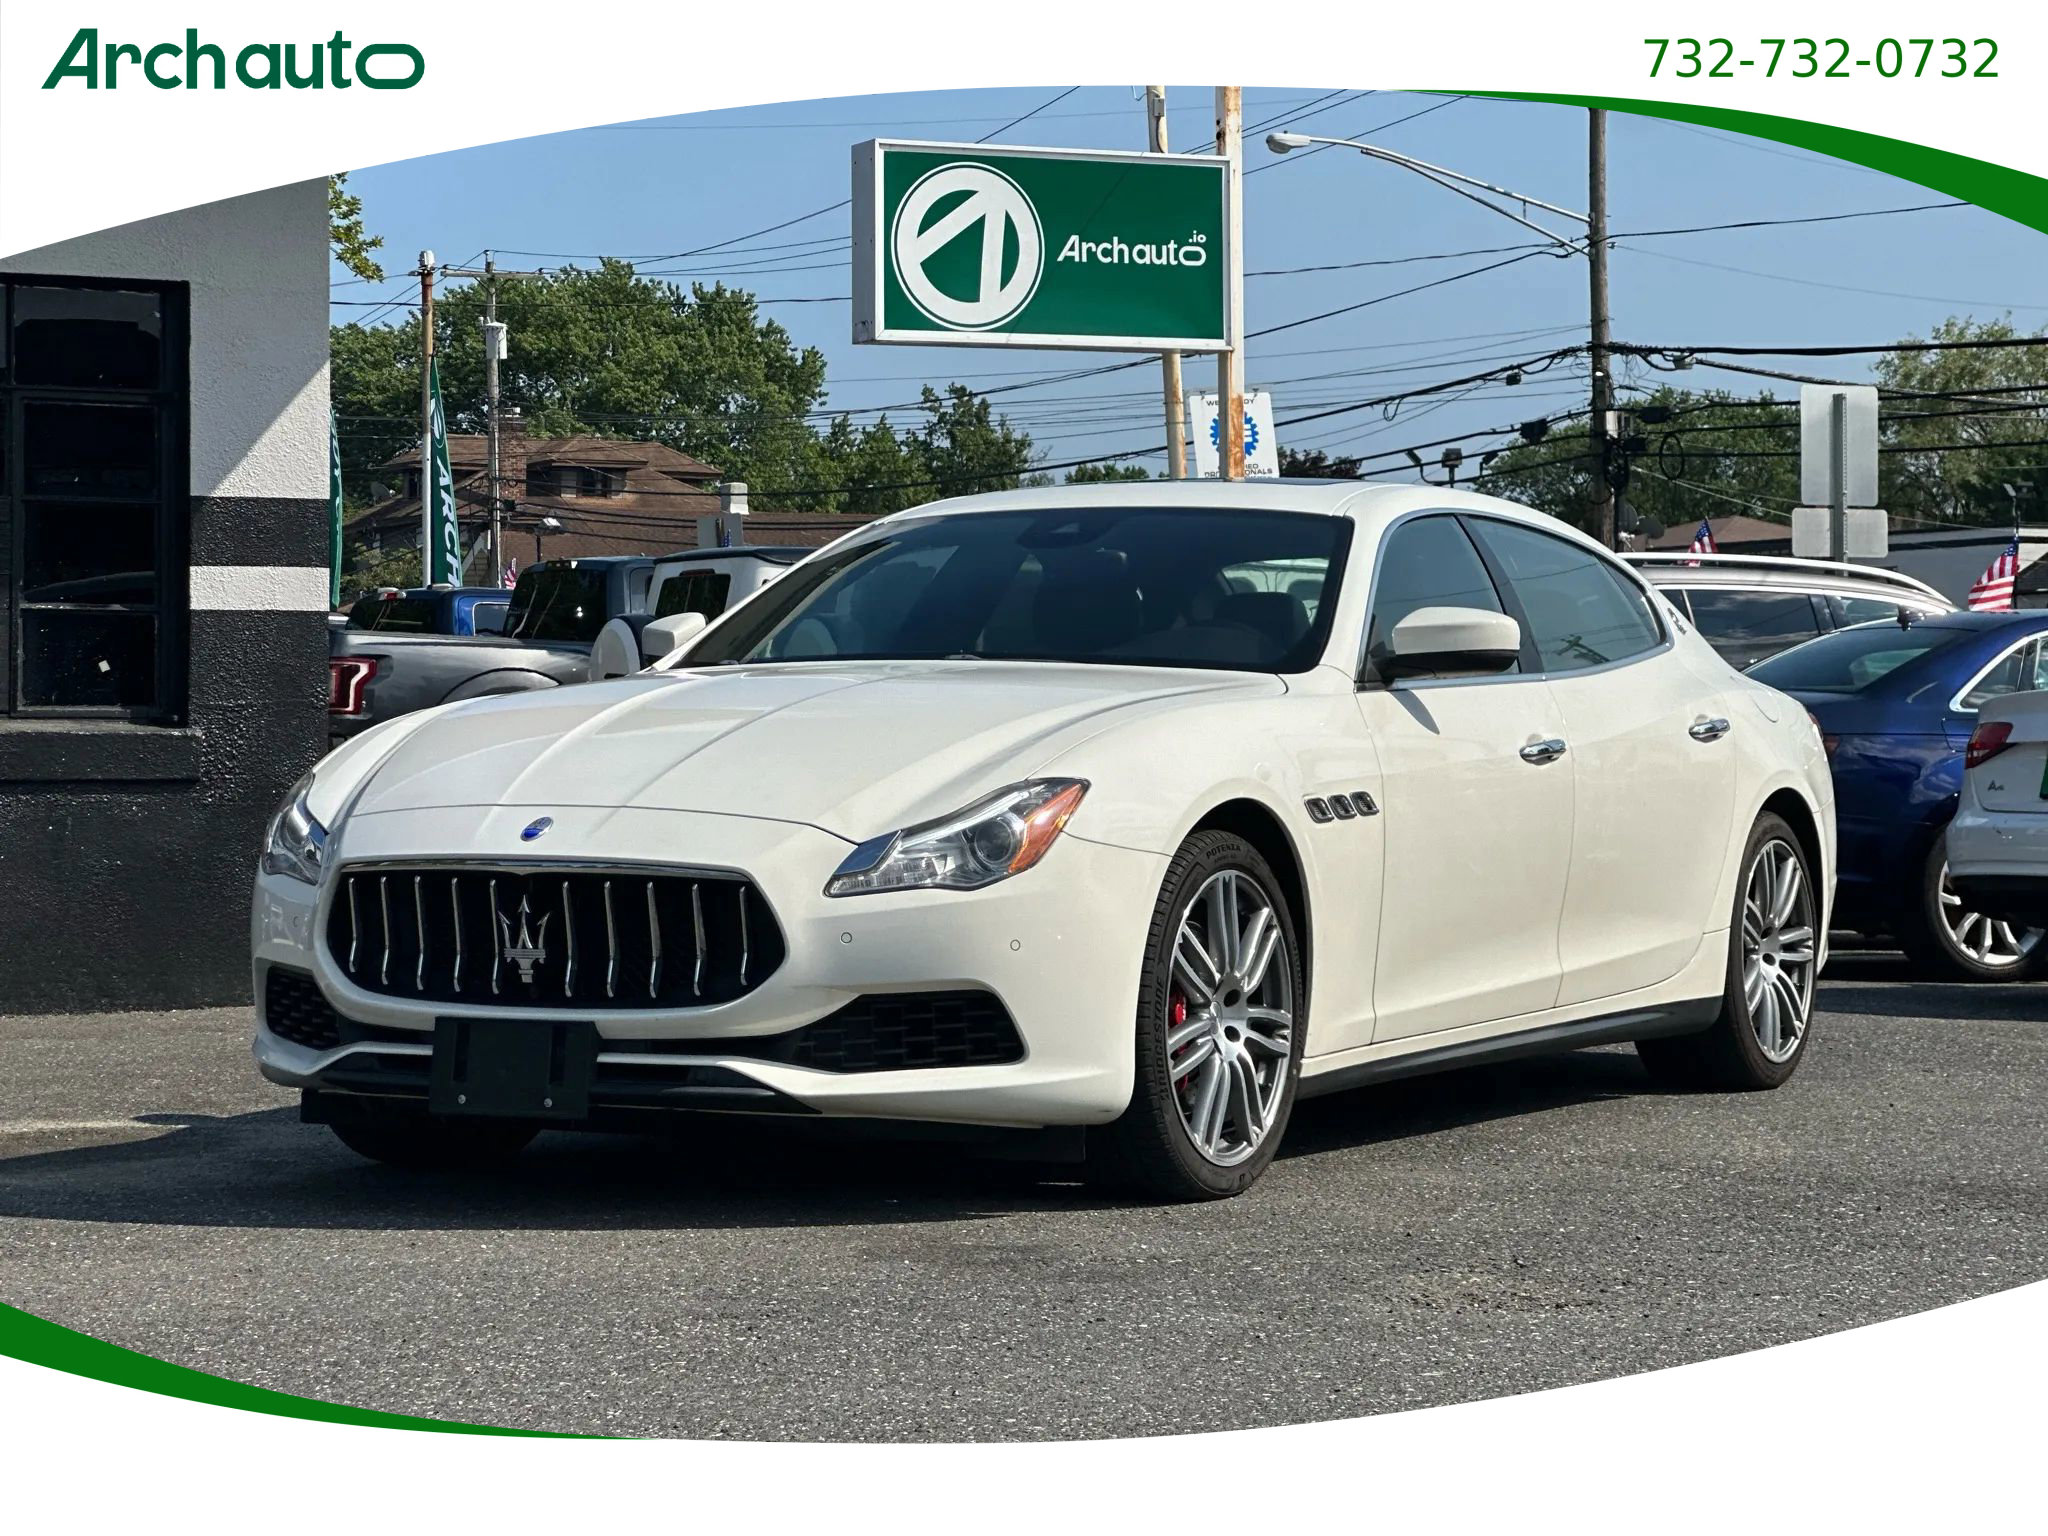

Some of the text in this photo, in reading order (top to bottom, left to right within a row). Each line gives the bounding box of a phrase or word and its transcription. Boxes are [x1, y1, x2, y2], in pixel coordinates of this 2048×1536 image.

[1189, 231, 1207, 243] .io
[436, 456, 461, 587] ARCH
[1206, 843, 1241, 859] POTENZA
[1153, 975, 1170, 1102] BRIDGESTONE
